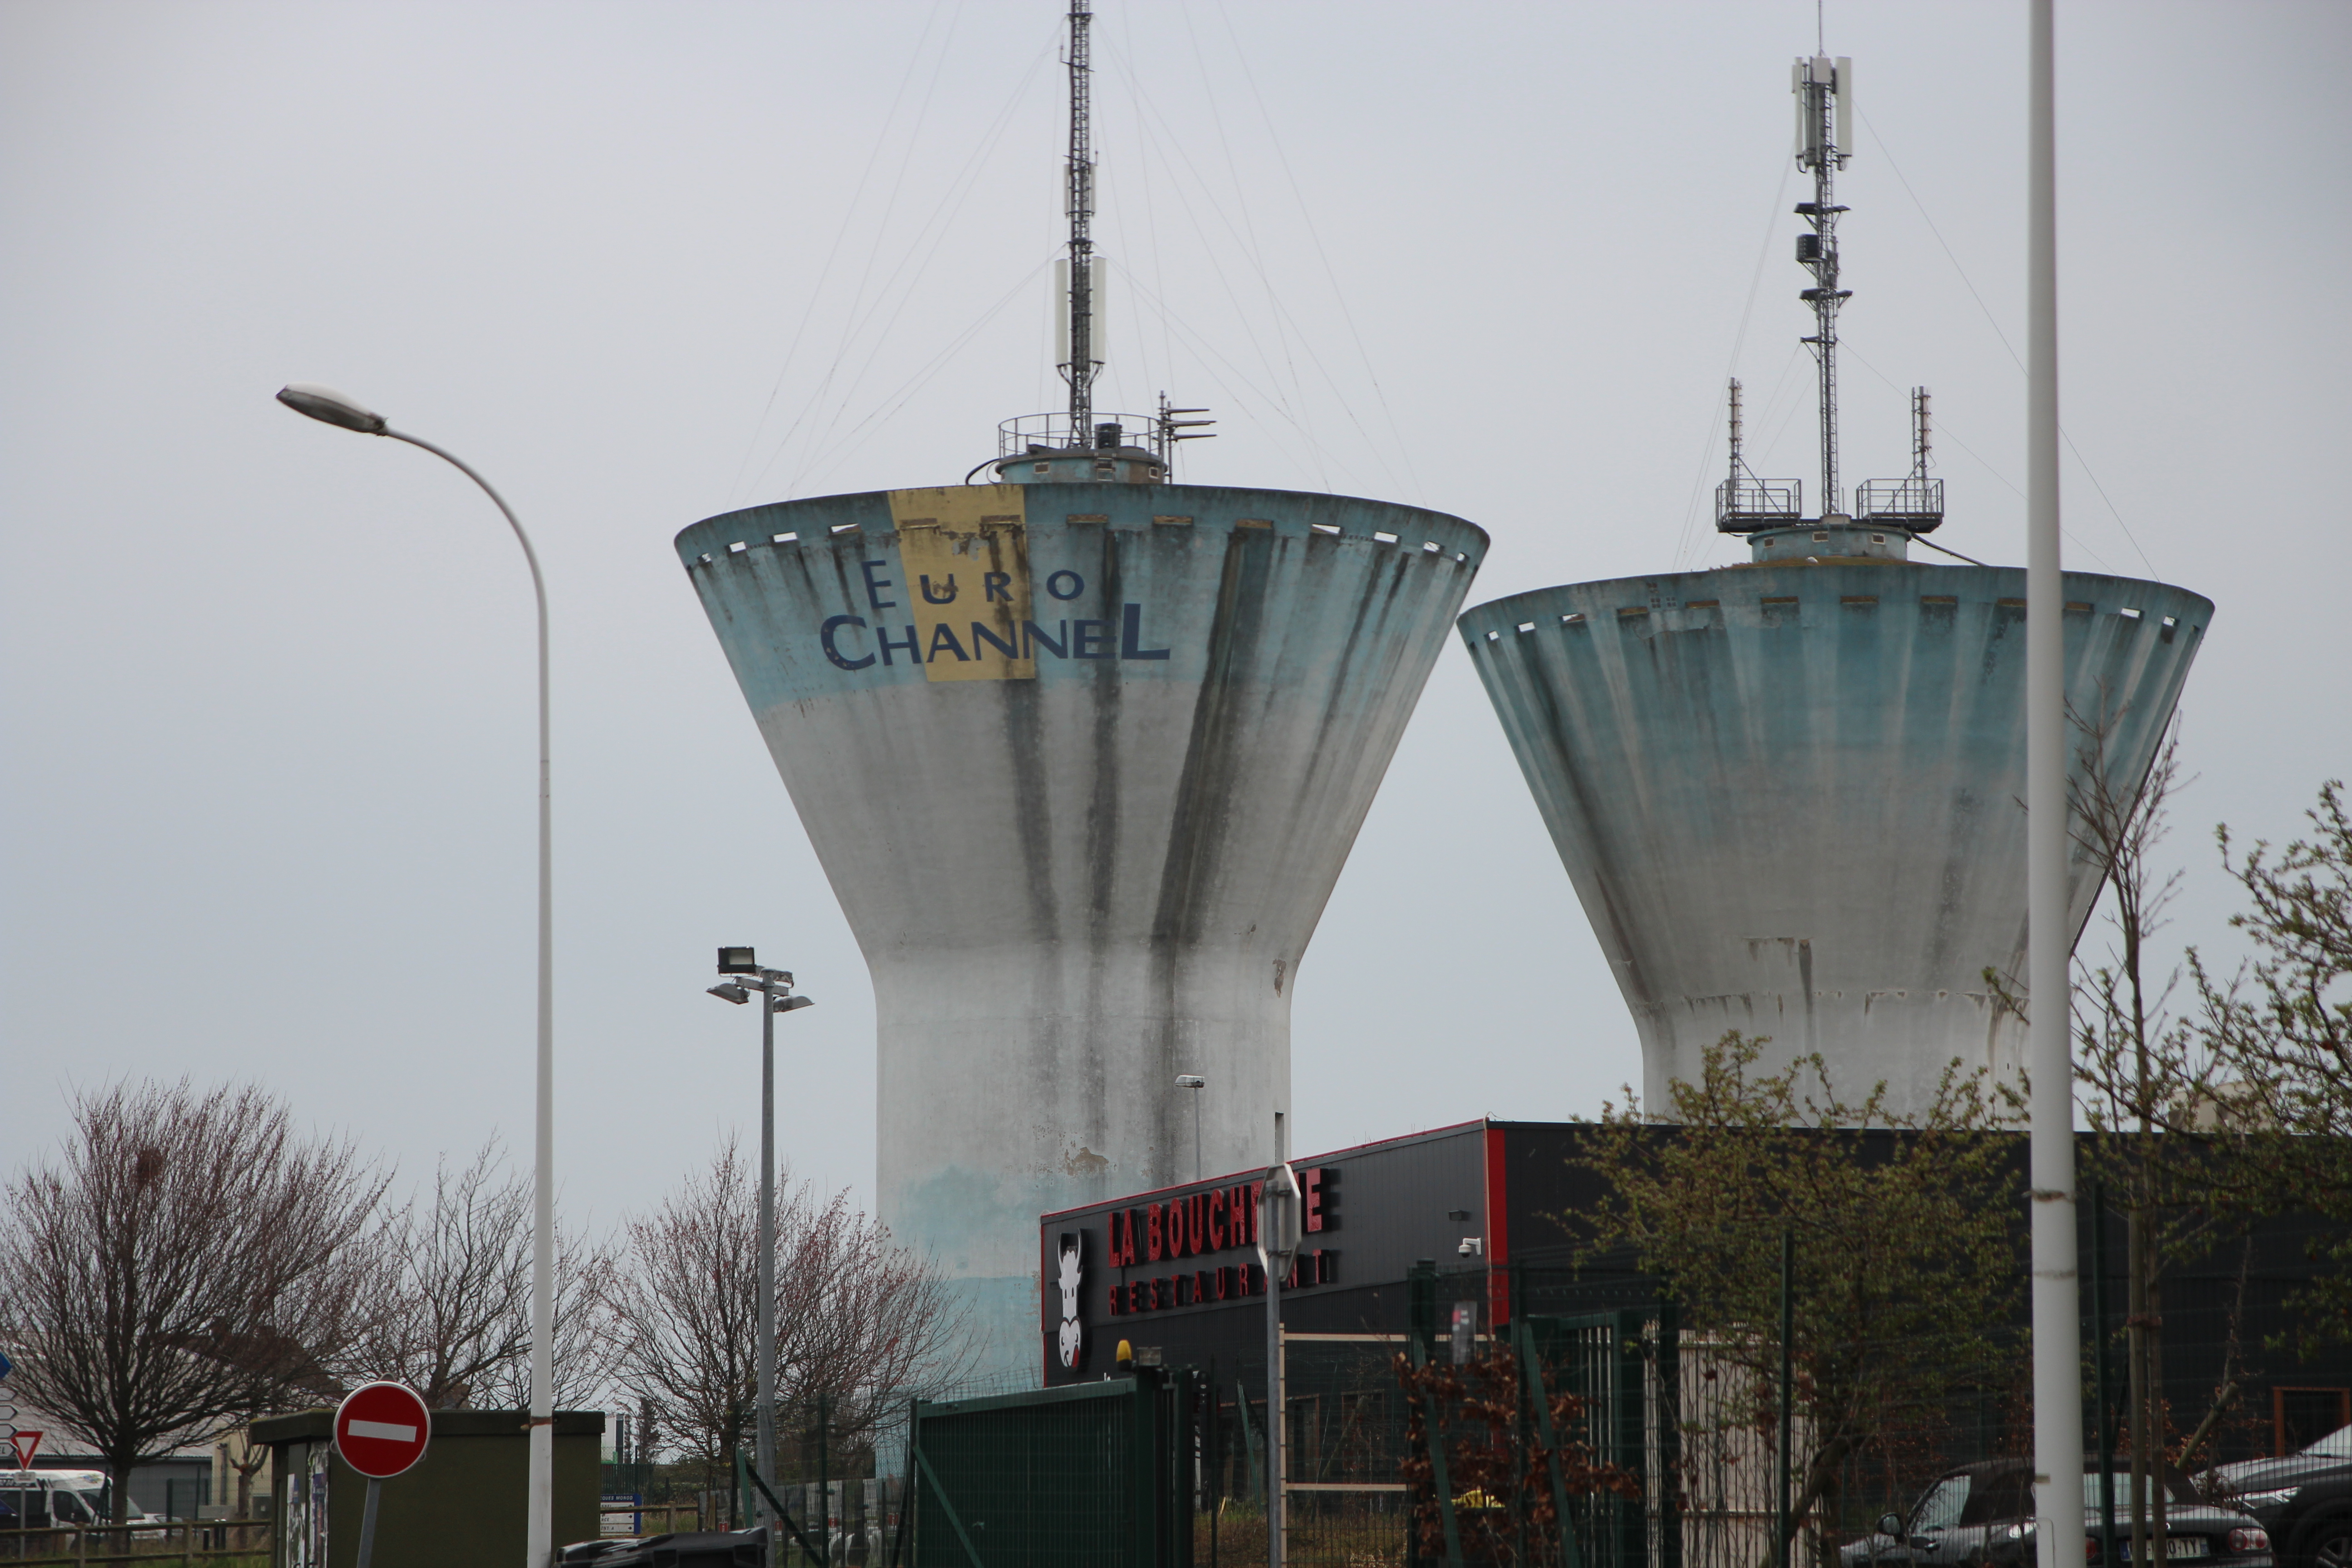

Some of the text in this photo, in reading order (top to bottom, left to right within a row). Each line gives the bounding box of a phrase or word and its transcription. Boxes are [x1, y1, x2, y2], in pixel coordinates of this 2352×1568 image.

[862, 559, 1085, 609] EURO
[820, 603, 1171, 671] CHANNEL
[1108, 1208, 1135, 1268] LA
[1109, 1249, 1322, 1316] RESTAURNT
